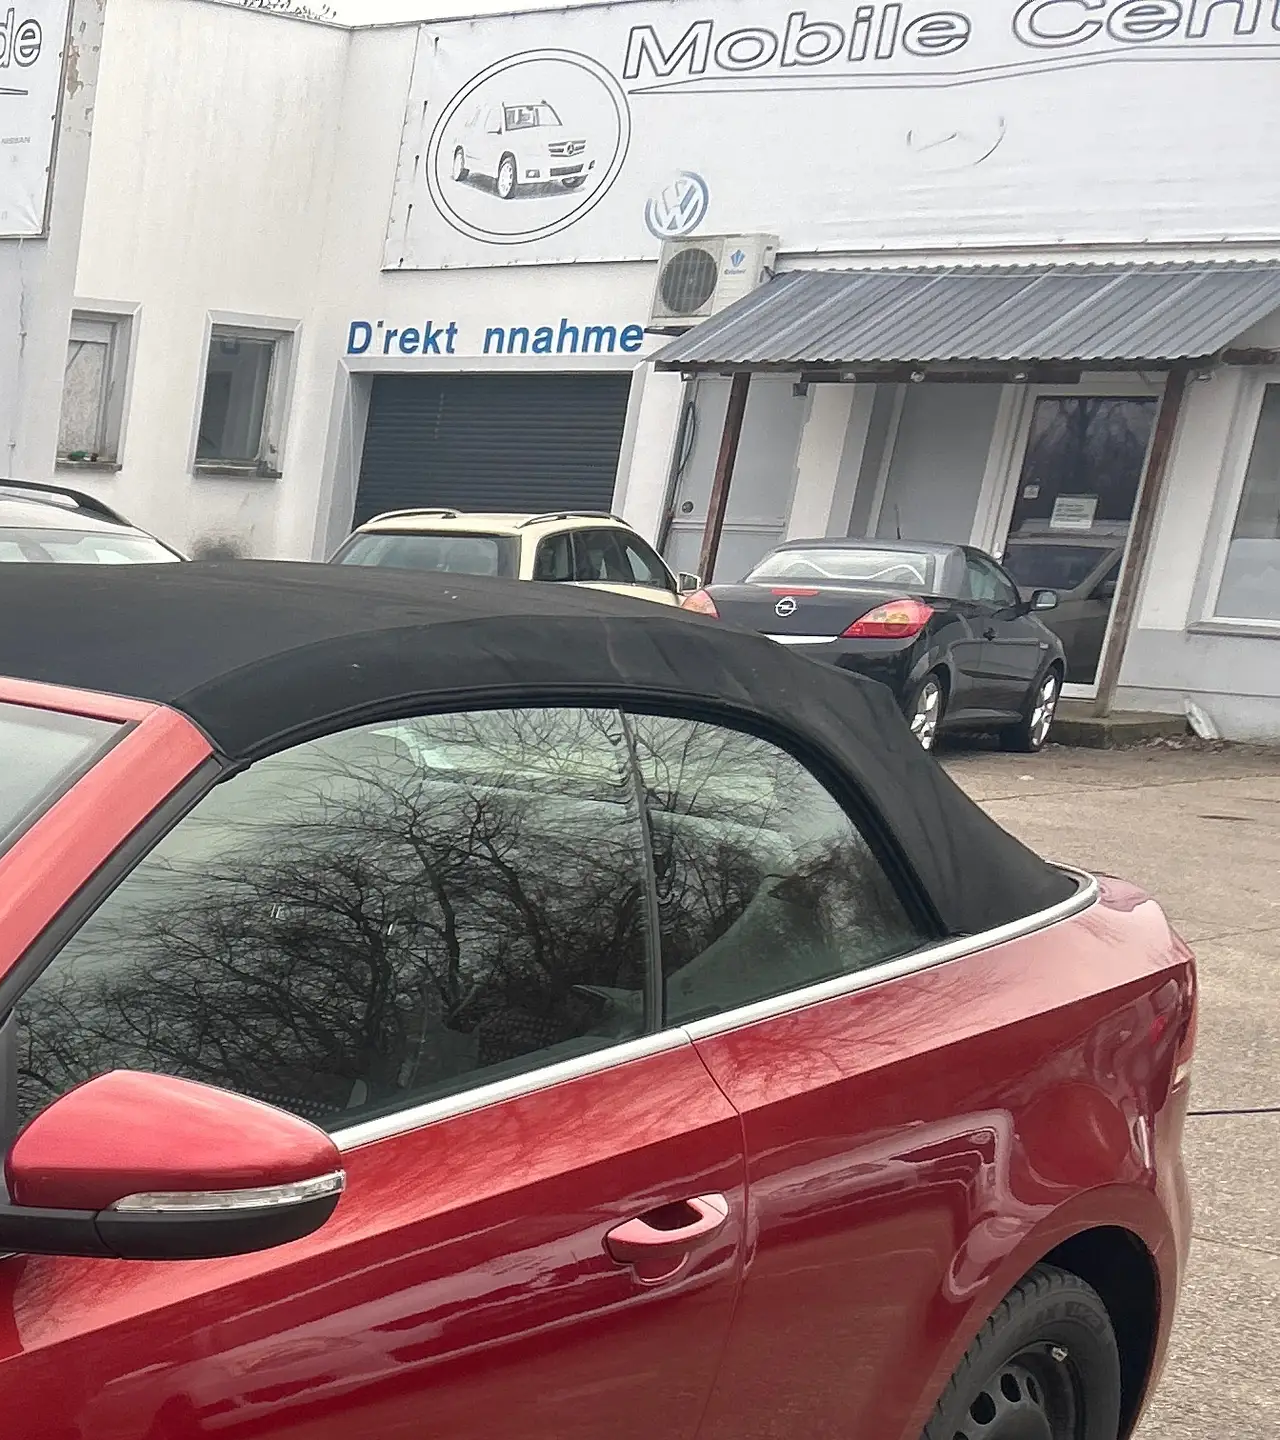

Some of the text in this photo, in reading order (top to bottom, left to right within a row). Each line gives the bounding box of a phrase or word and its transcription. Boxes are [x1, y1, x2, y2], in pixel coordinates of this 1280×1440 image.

[622, 0, 1280, 79] Mobile Cen
[346, 320, 458, 354] Drekt
